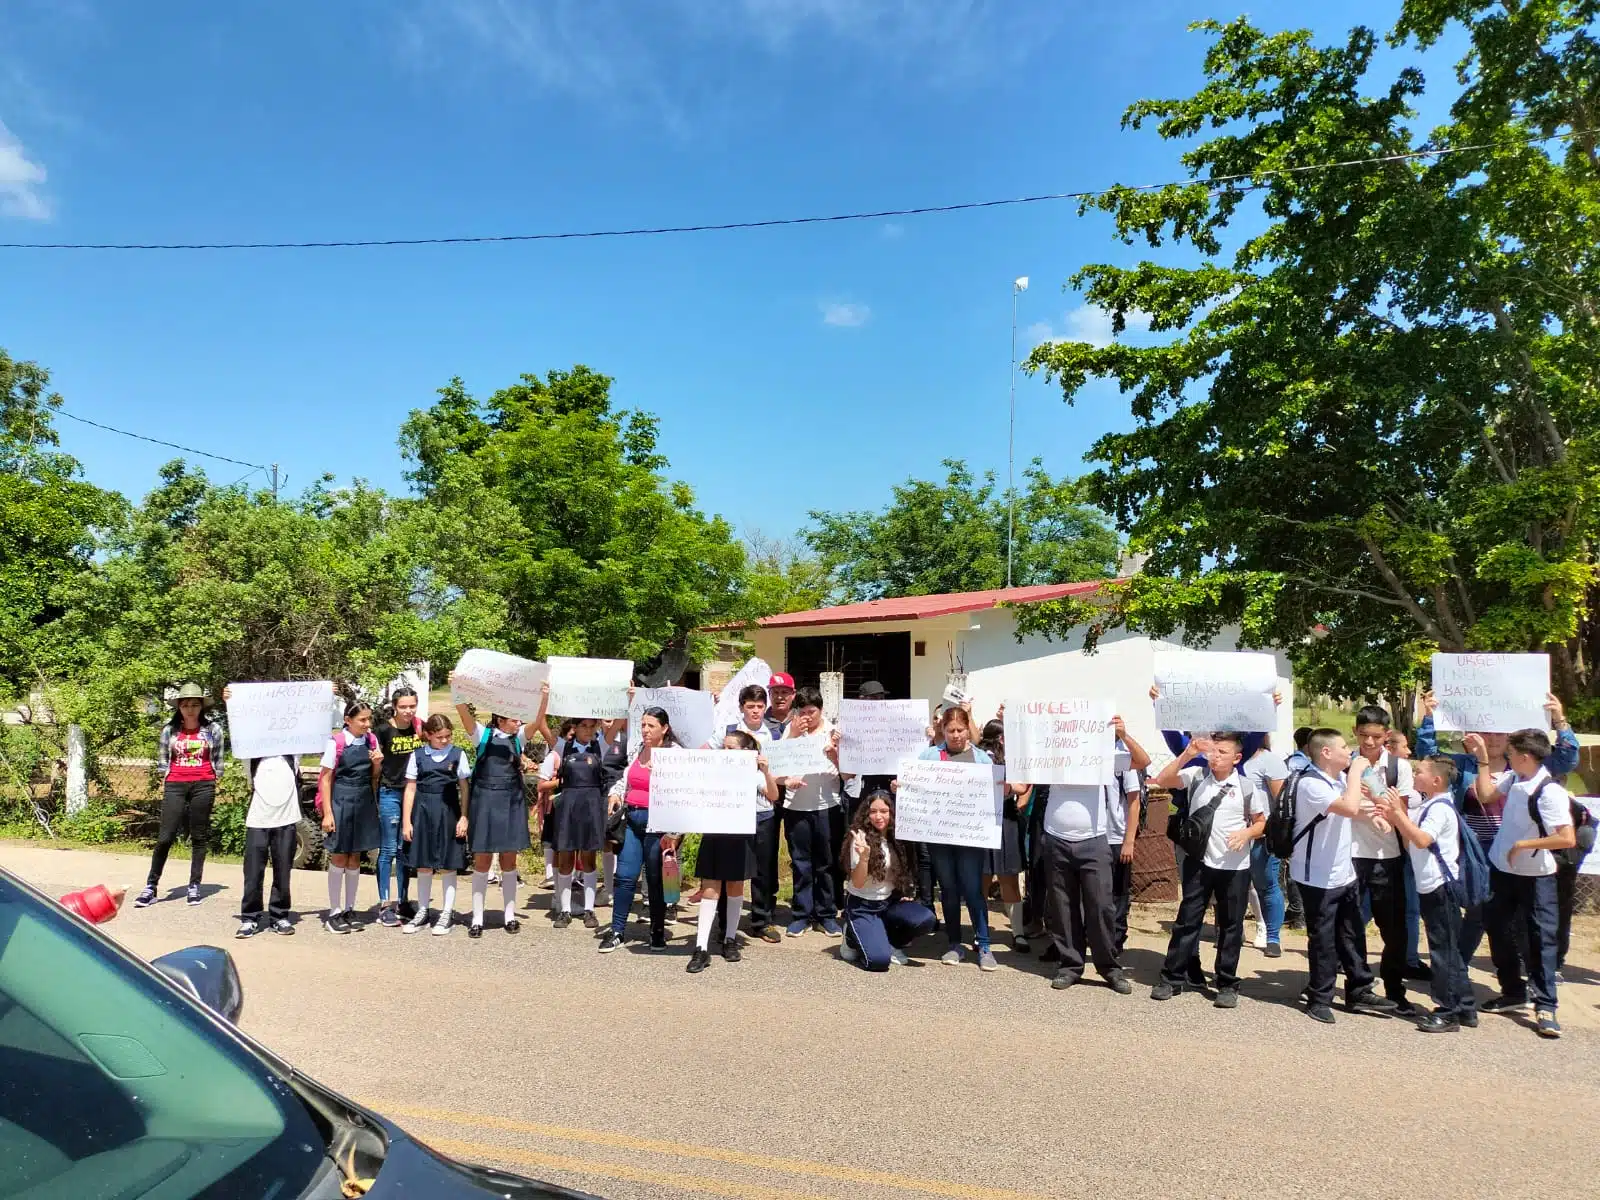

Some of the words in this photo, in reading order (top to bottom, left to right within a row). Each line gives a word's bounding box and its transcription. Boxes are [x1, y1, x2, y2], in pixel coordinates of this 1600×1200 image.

[645, 689, 684, 704] URGE
[1441, 712, 1496, 727] AULAS
[1080, 755, 1104, 767] 220
